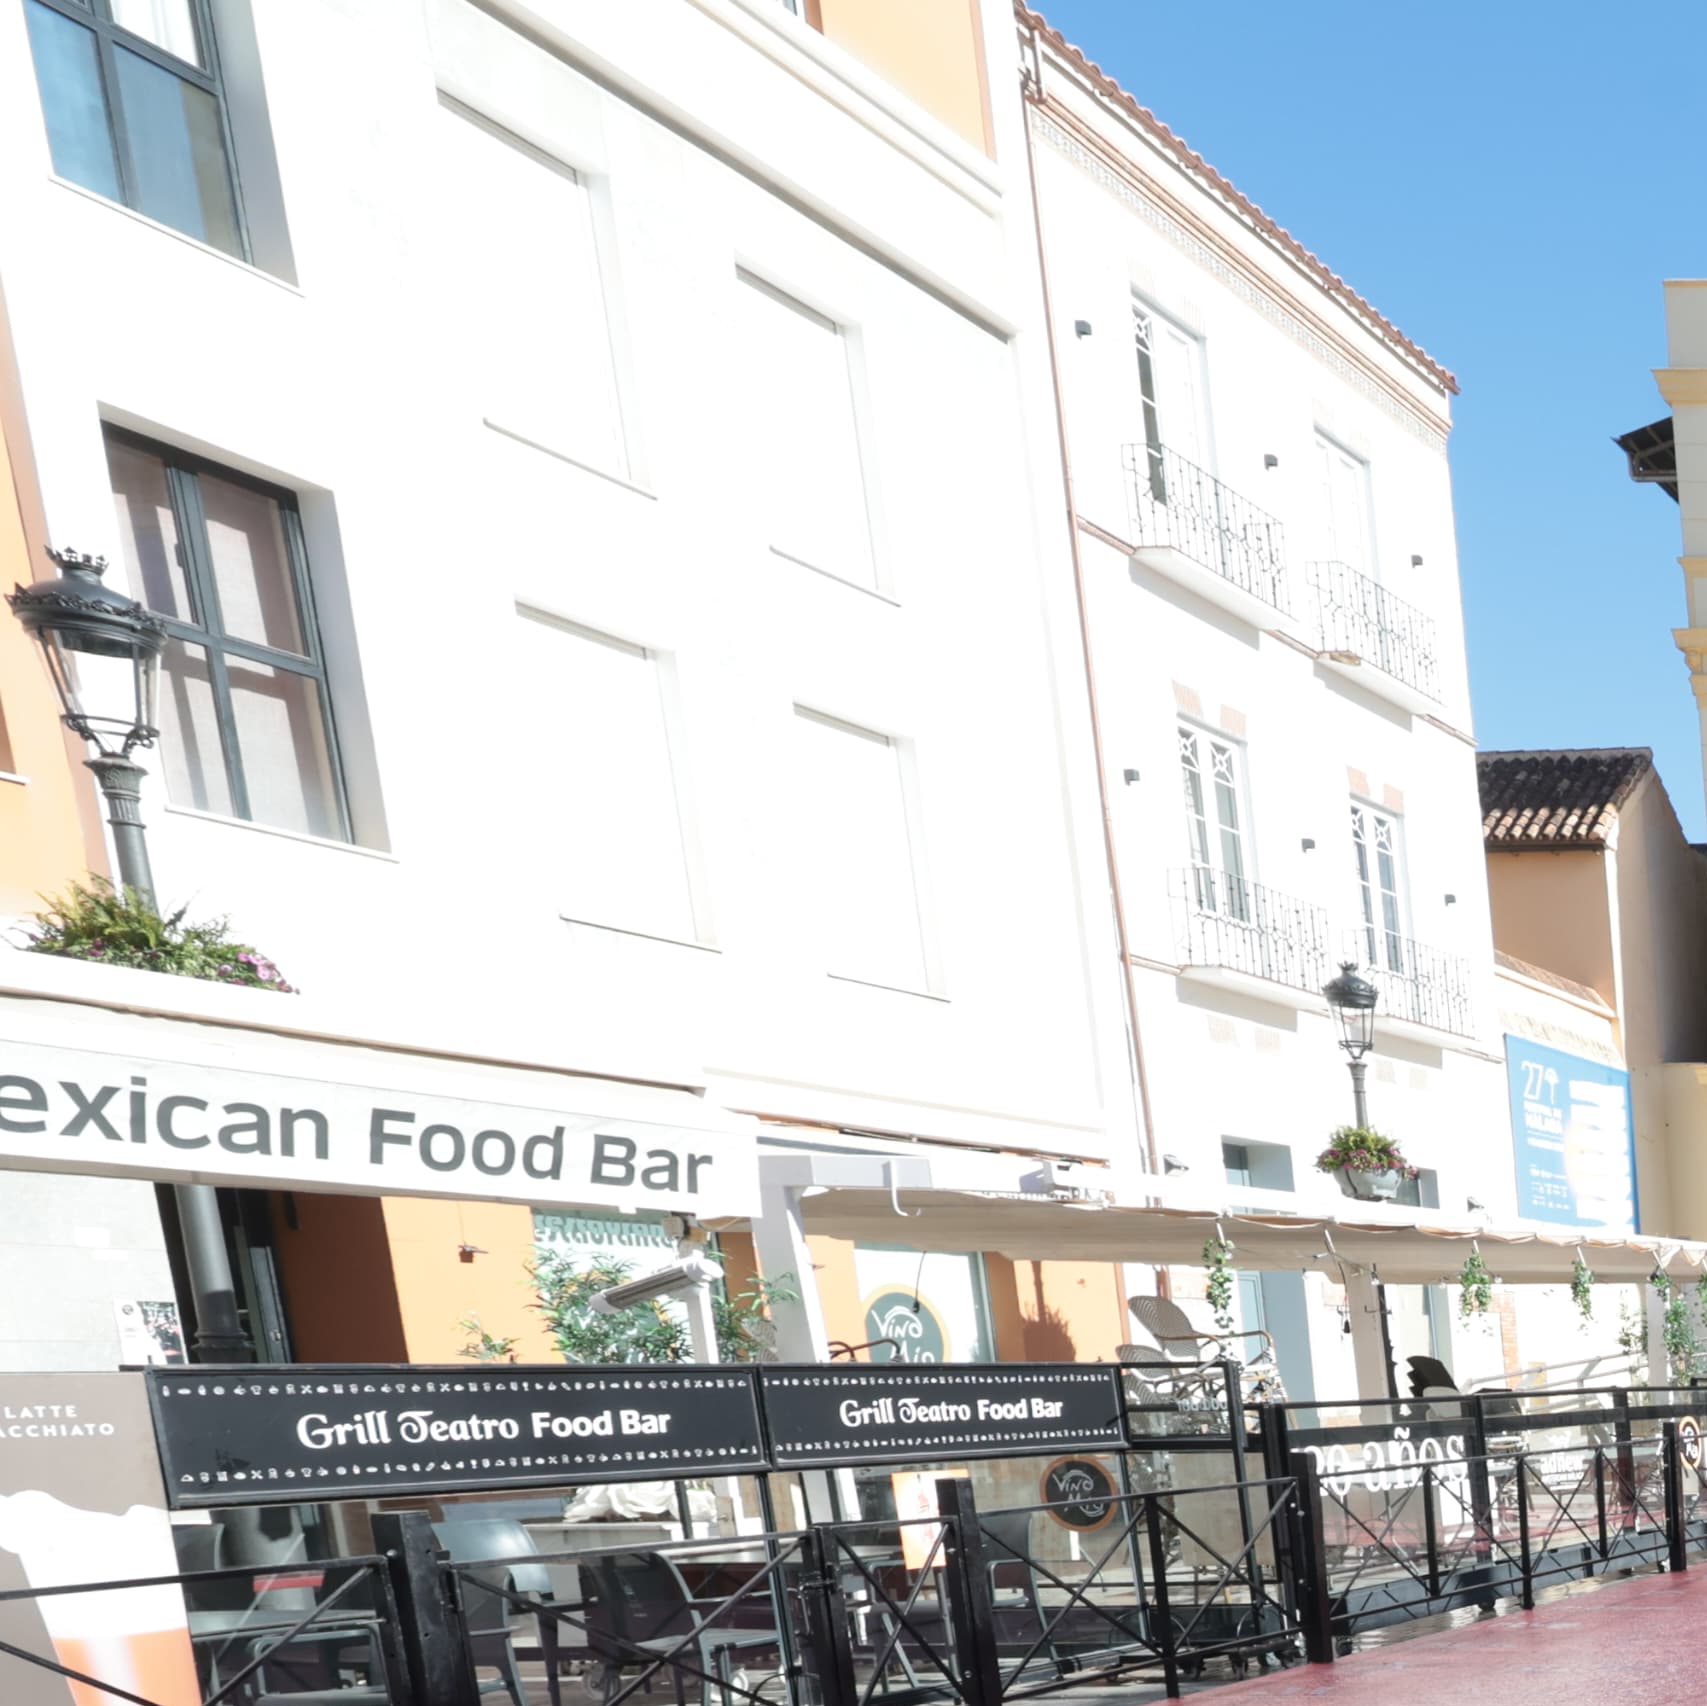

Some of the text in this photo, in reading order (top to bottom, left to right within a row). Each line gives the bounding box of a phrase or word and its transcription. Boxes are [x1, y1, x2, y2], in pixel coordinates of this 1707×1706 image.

[369, 1106, 566, 1181] Food
[590, 1134, 713, 1194] Bar
[4, 1405, 77, 1419] LATTE
[297, 1409, 671, 1449] Grill Teatro Food Bar
[840, 1398, 1063, 1427] Grill Teatro Food Bar
[1363, 1427, 1467, 1492] años
